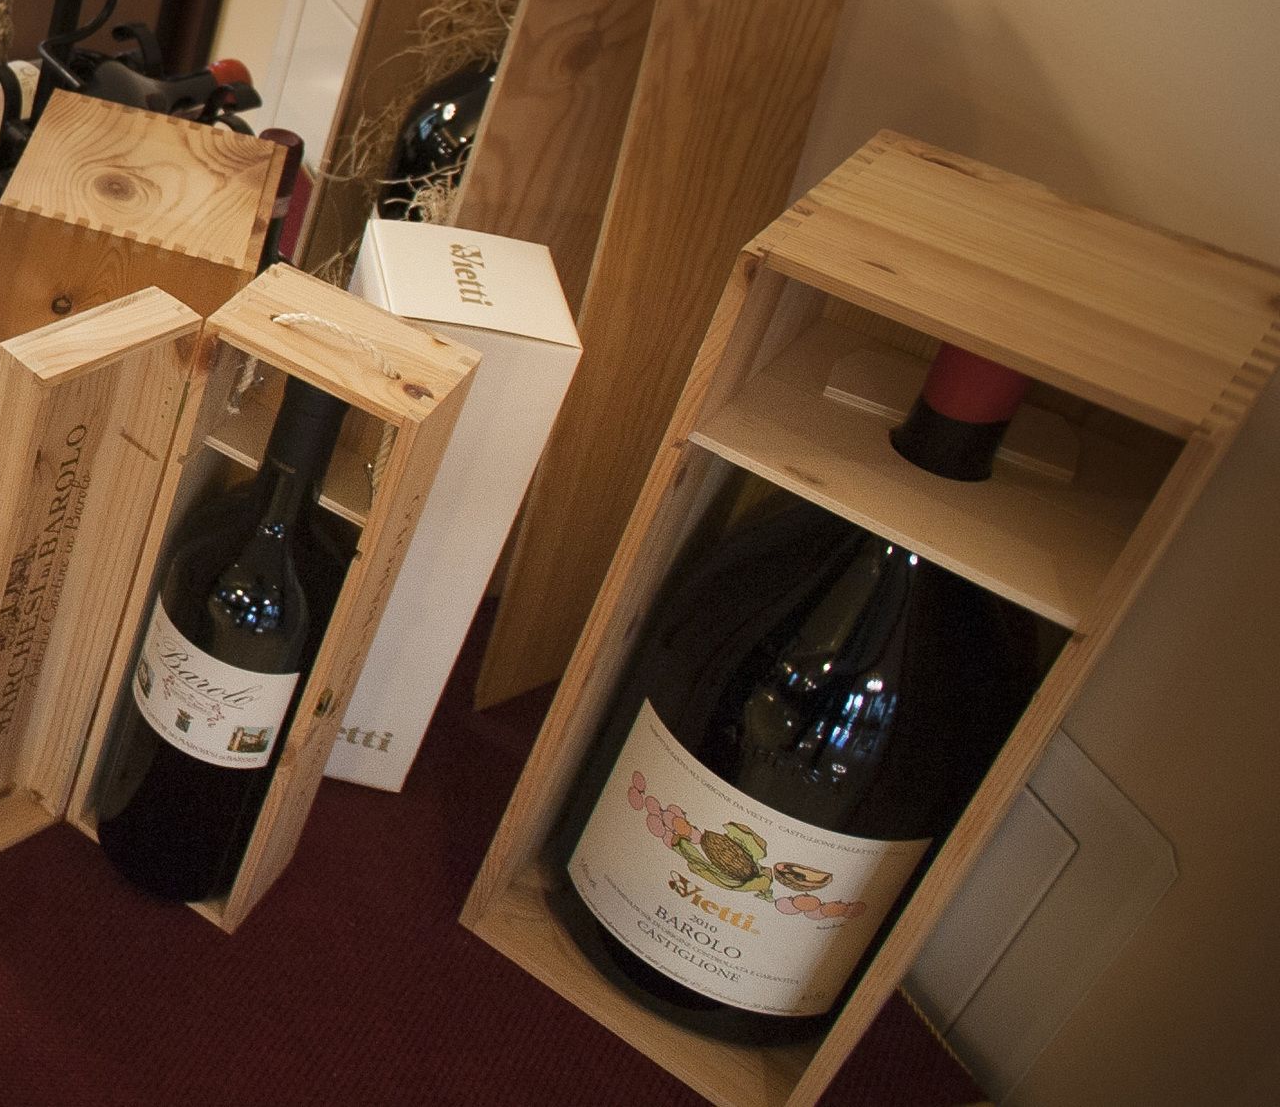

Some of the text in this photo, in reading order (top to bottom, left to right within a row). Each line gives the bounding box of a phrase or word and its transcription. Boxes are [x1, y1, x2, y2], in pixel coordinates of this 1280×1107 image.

[449, 243, 493, 307] Vietti
[38, 424, 88, 560] BAROLO
[64, 469, 91, 531] Barolo
[159, 638, 263, 708] Barolo
[338, 726, 394, 752] etti
[655, 905, 741, 959] BAROLO
[668, 869, 757, 932] Vietti
[689, 914, 718, 934] 2010
[637, 920, 742, 983] CASTIGLIONE
